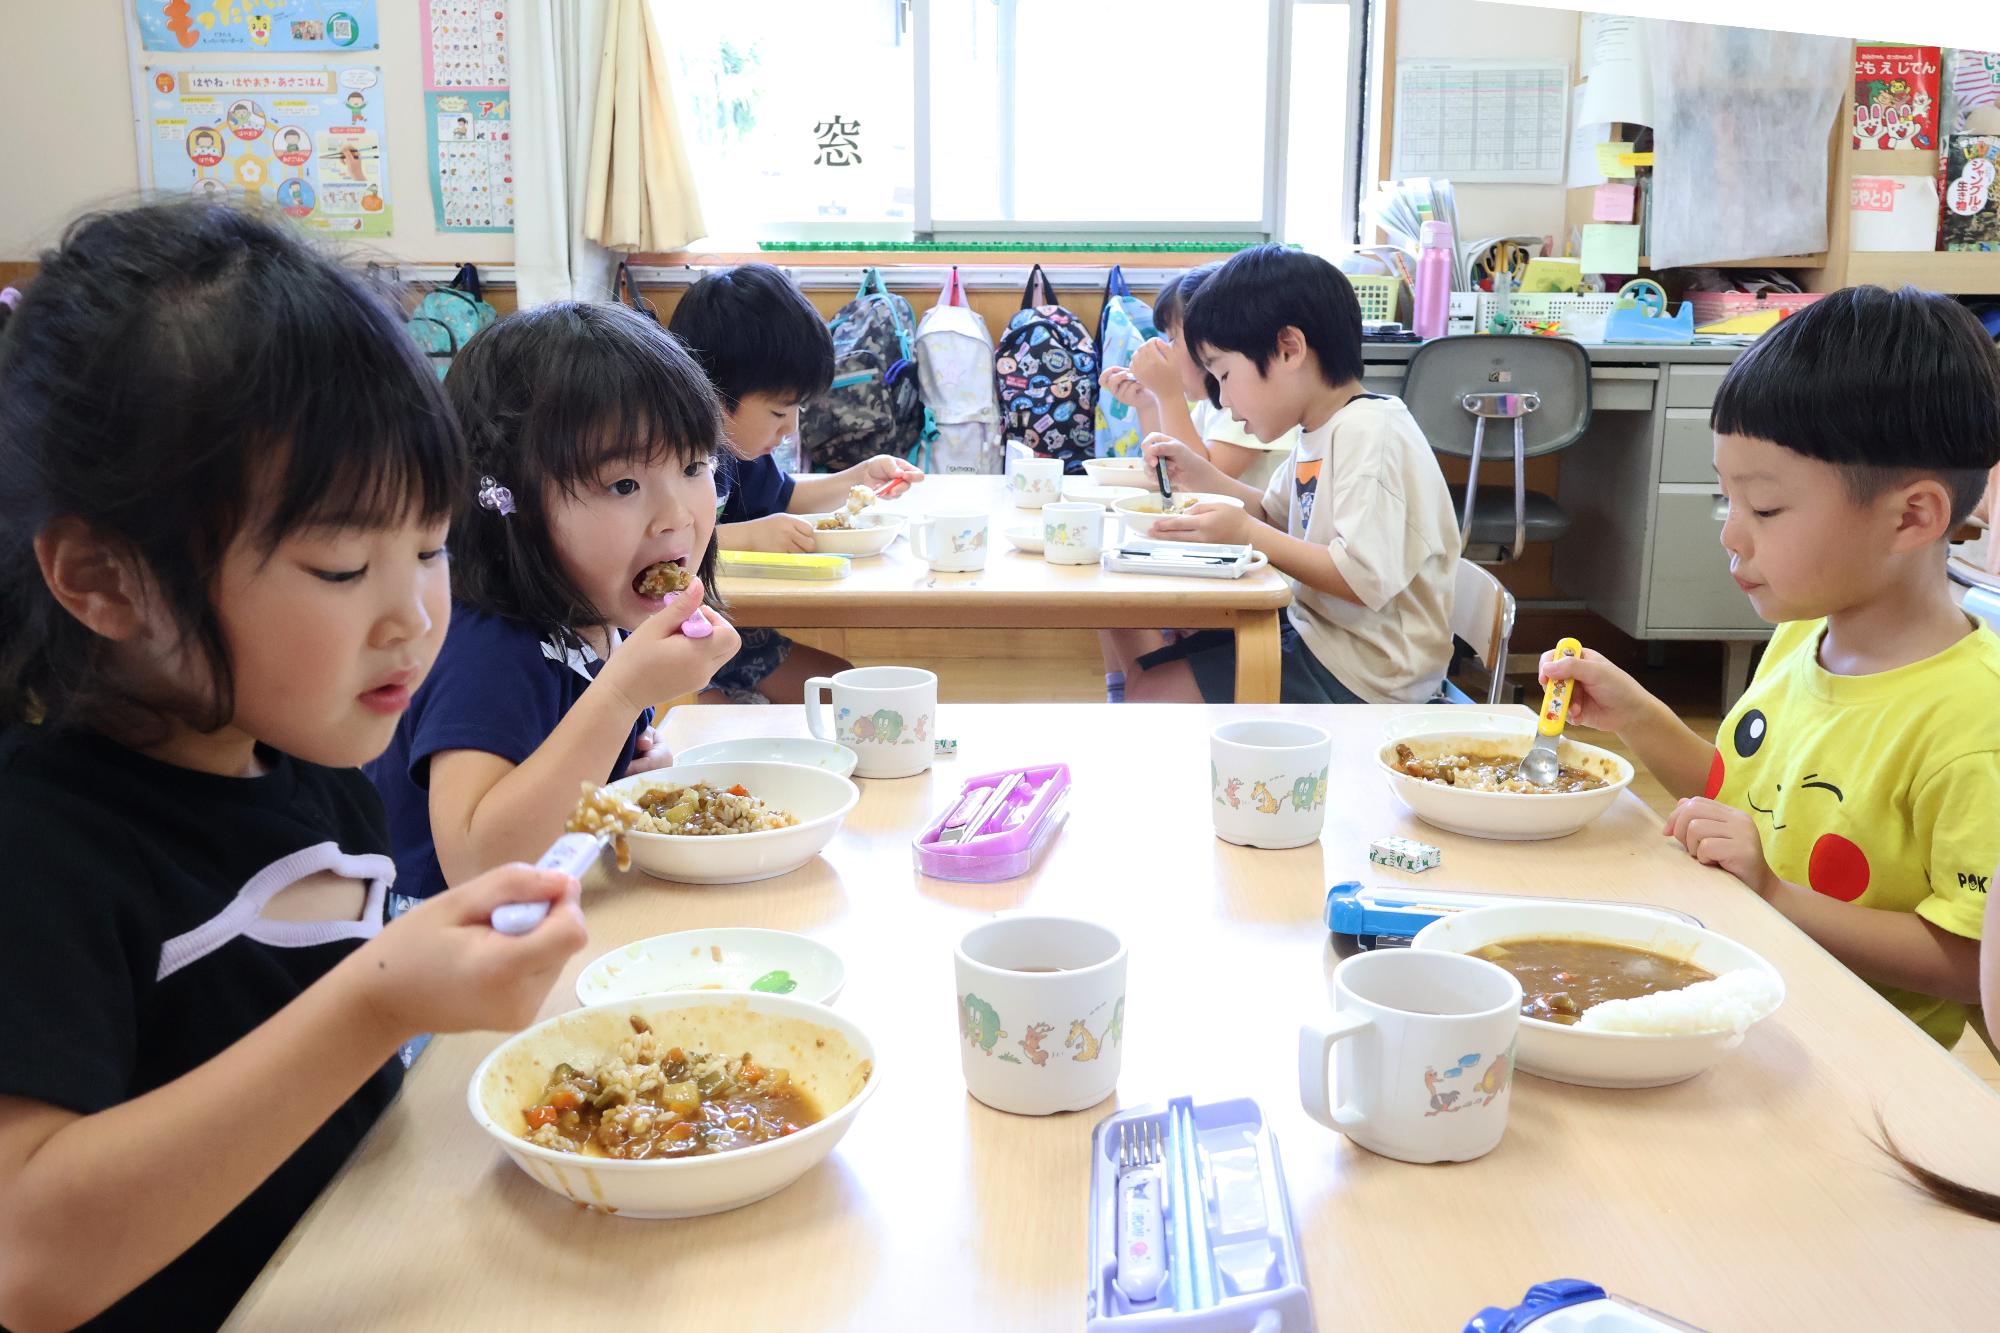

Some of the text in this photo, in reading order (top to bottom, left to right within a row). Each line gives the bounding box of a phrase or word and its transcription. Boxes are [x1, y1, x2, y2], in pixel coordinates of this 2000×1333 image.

[1880, 62, 1893, 74] え
[1898, 61, 1936, 74] じてん
[476, 99, 510, 119] アイ
[813, 115, 863, 167] 窓
[1957, 872, 1993, 894] POK
